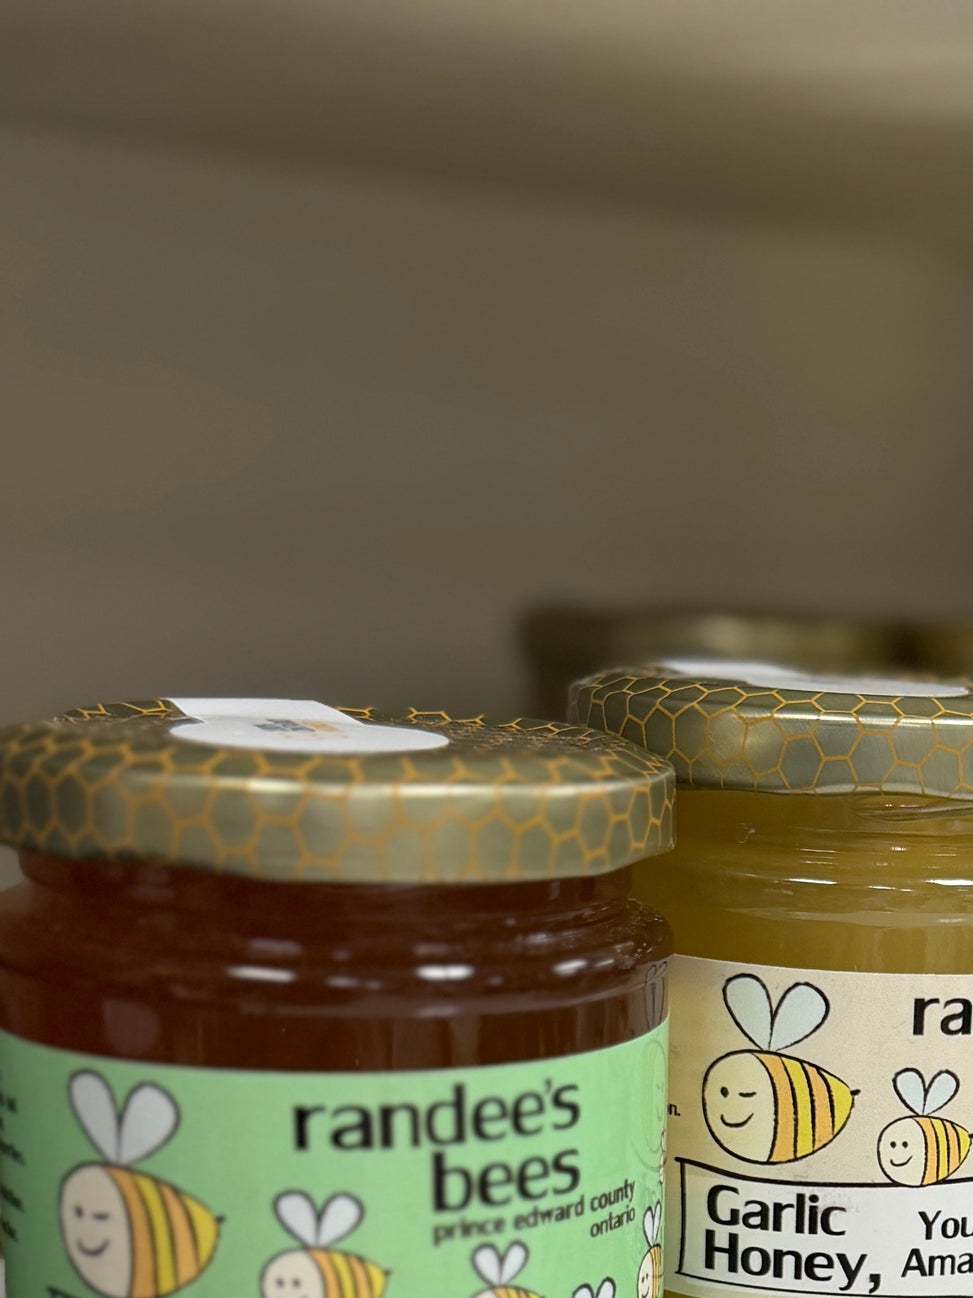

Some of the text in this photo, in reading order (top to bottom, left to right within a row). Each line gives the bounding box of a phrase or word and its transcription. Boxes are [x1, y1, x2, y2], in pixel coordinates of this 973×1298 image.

[292, 1077, 581, 1151] randee's
[431, 1148, 581, 1214] bees
[433, 1178, 635, 1247] prince edward county
[706, 1184, 847, 1236] Garlic
[590, 1204, 635, 1238] ontario
[703, 1228, 882, 1294] Honey,
